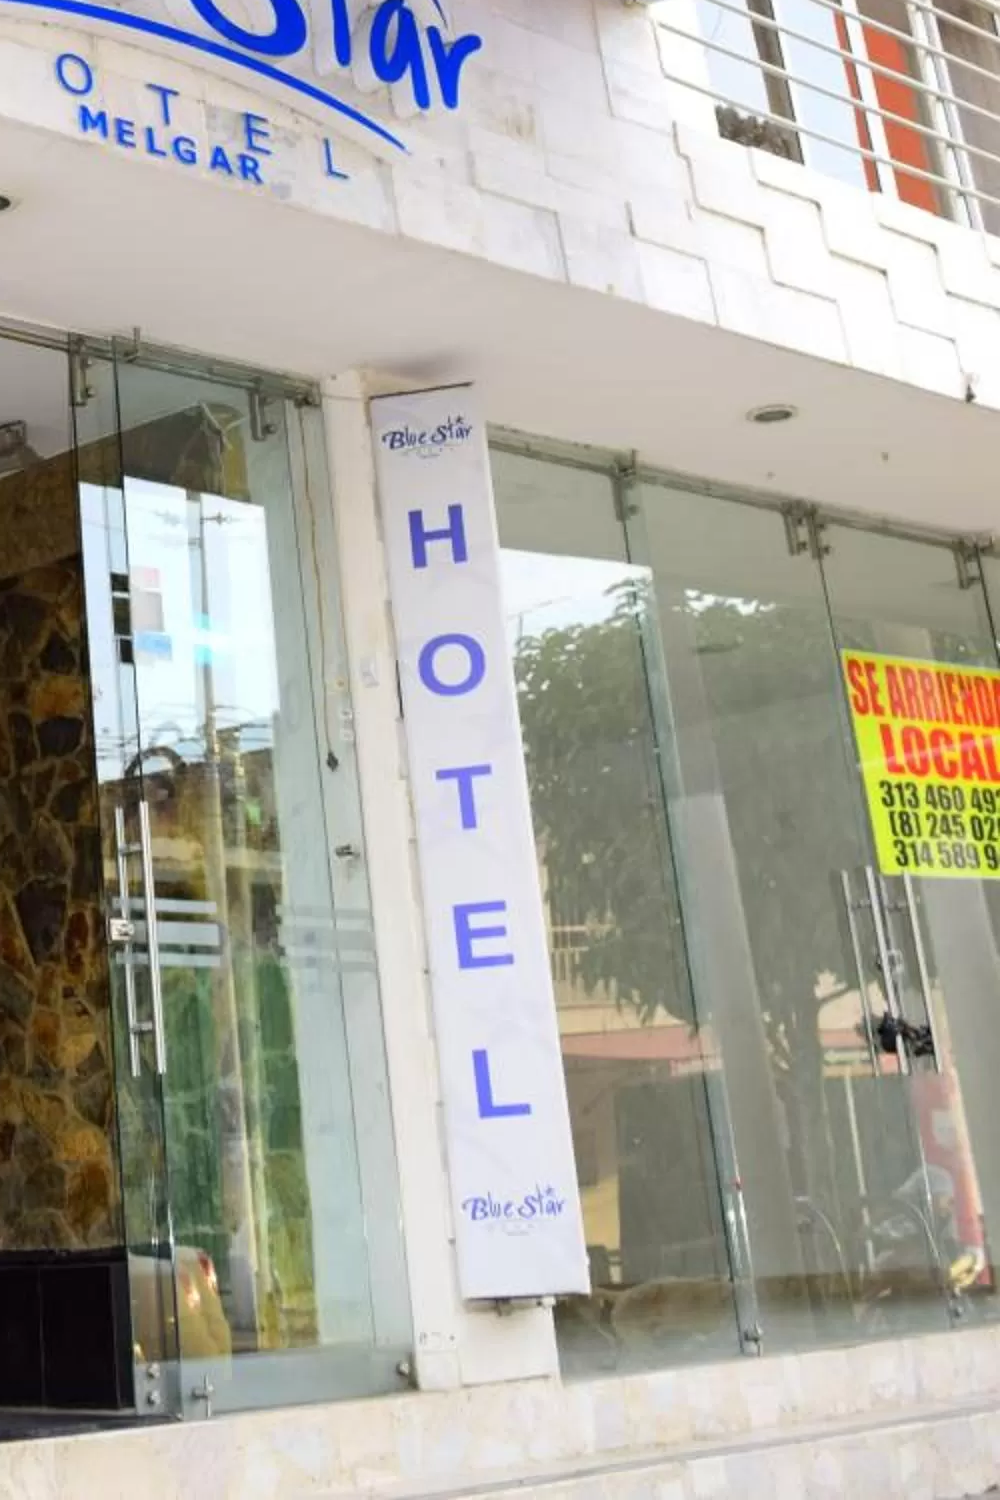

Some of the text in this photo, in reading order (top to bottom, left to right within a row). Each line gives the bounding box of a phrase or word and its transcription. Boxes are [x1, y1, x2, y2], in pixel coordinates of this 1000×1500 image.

[78, 104, 265, 185] MELGAR
[381, 413, 473, 450] Blue Star
[847, 657, 885, 717] SE
[879, 723, 1000, 783] LOCAL
[407, 503, 532, 1120] HOTEL
[879, 780, 920, 809] 313
[925, 784, 966, 813] 460
[926, 811, 967, 839] 245
[970, 814, 1000, 843] 02
[893, 838, 935, 868] 314
[461, 1183, 566, 1221] Blue Star
